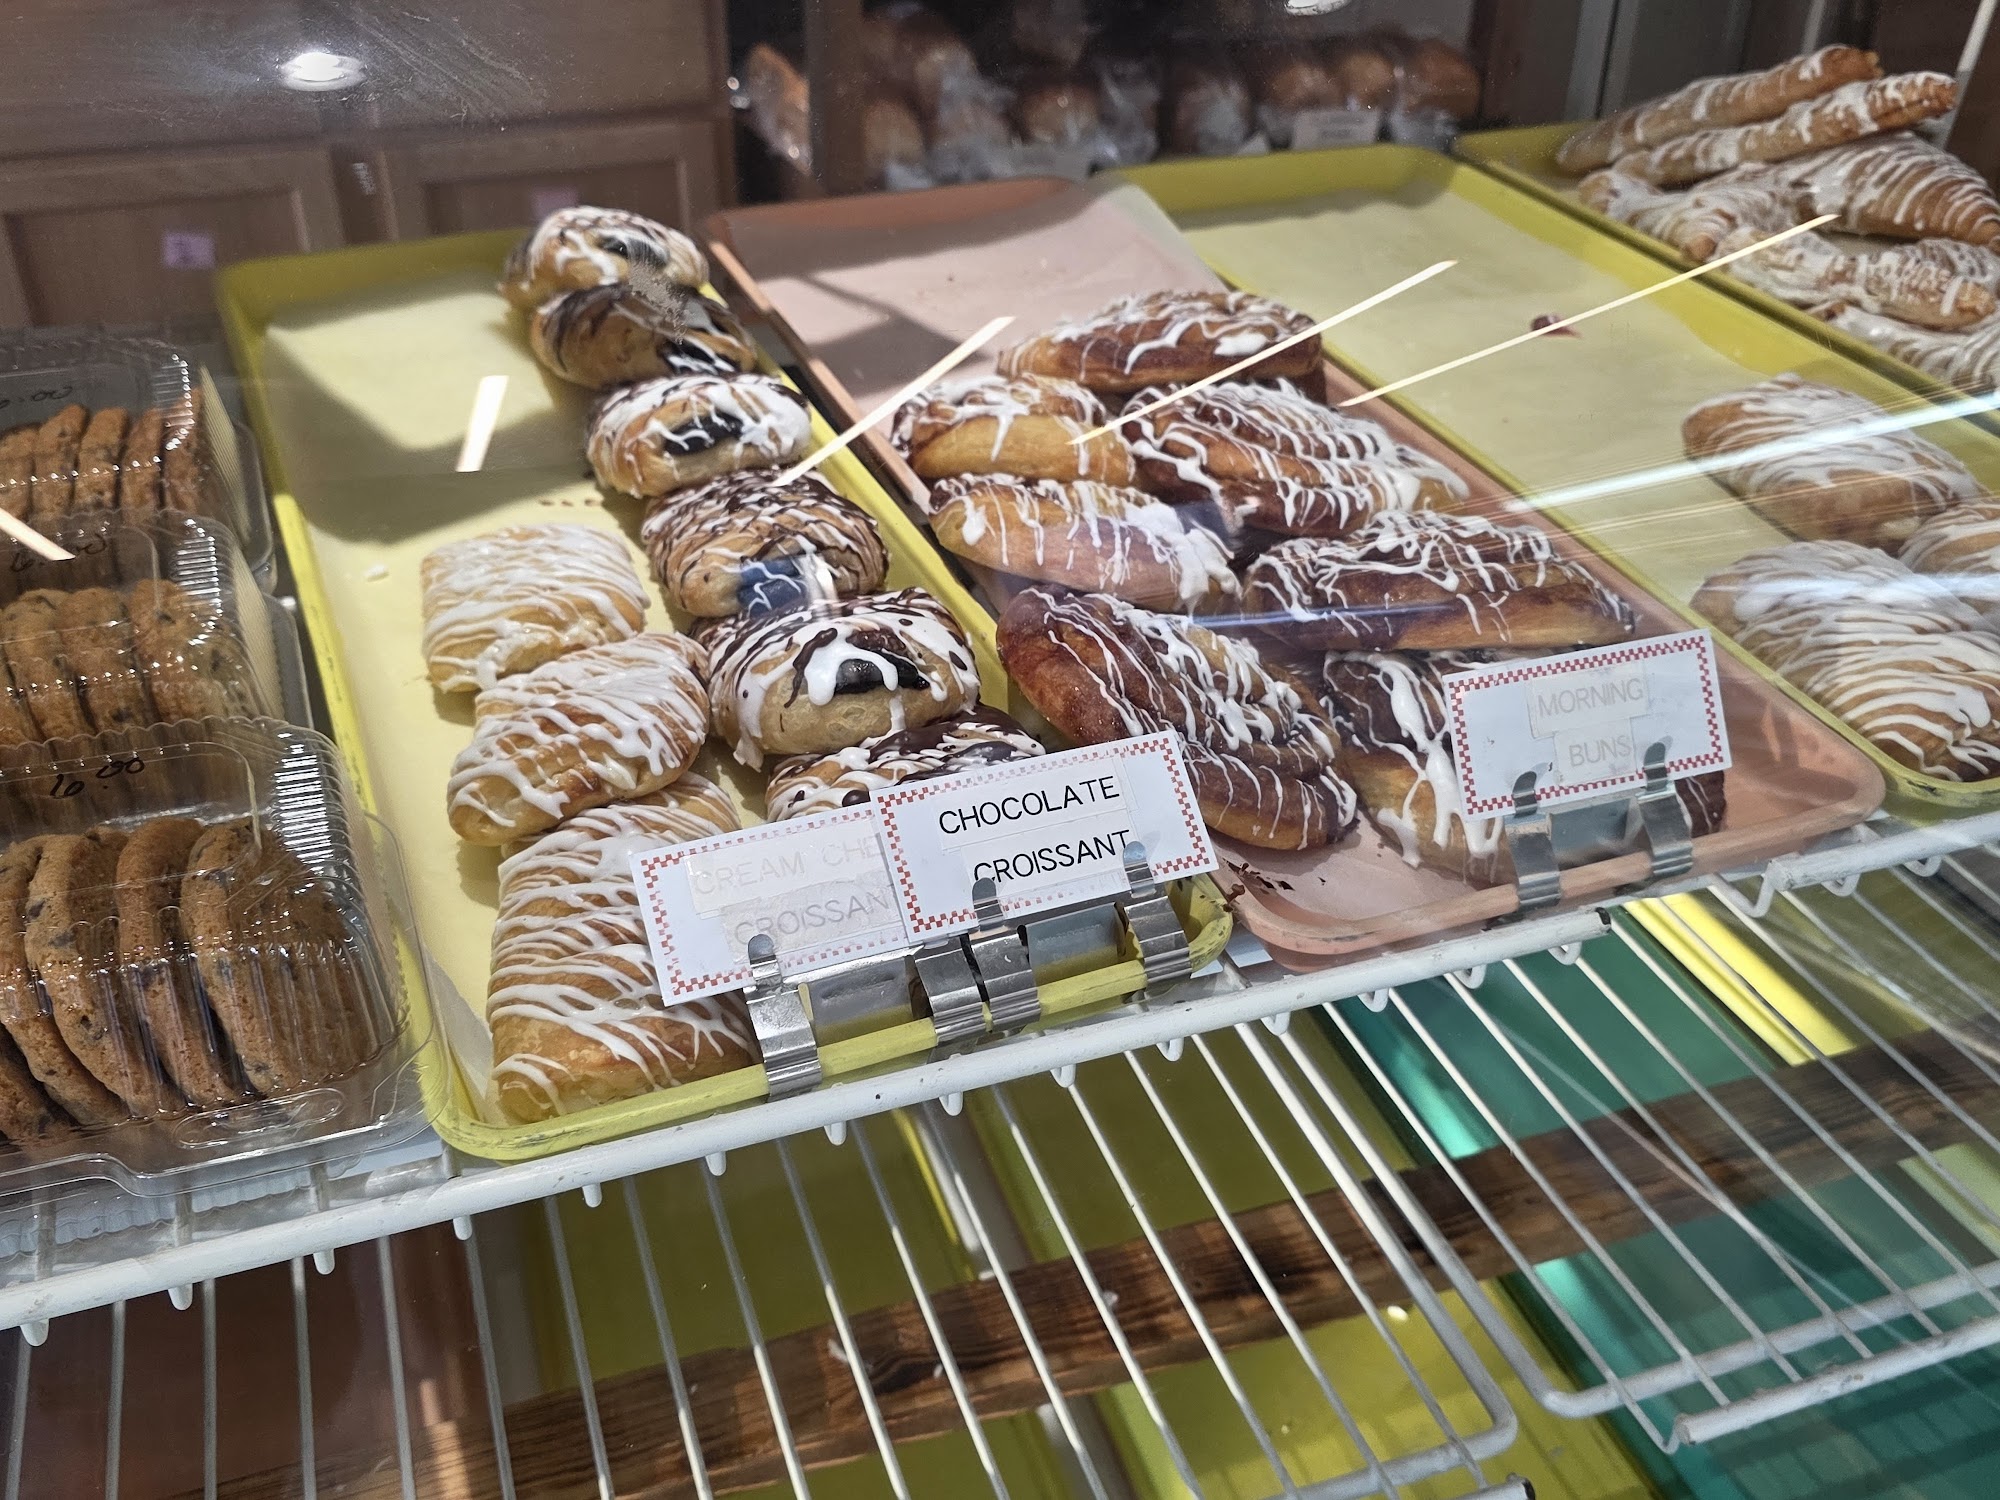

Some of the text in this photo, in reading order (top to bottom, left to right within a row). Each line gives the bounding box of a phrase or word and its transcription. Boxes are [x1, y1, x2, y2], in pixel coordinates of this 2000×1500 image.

[1537, 677, 1645, 718] MORNING
[1568, 735, 1632, 768] BUNS
[939, 775, 1120, 834] CHOCOLATE
[695, 835, 882, 895] CREAM CHE
[973, 829, 1130, 883] CROISSANT
[734, 883, 895, 945] CROISSAN
